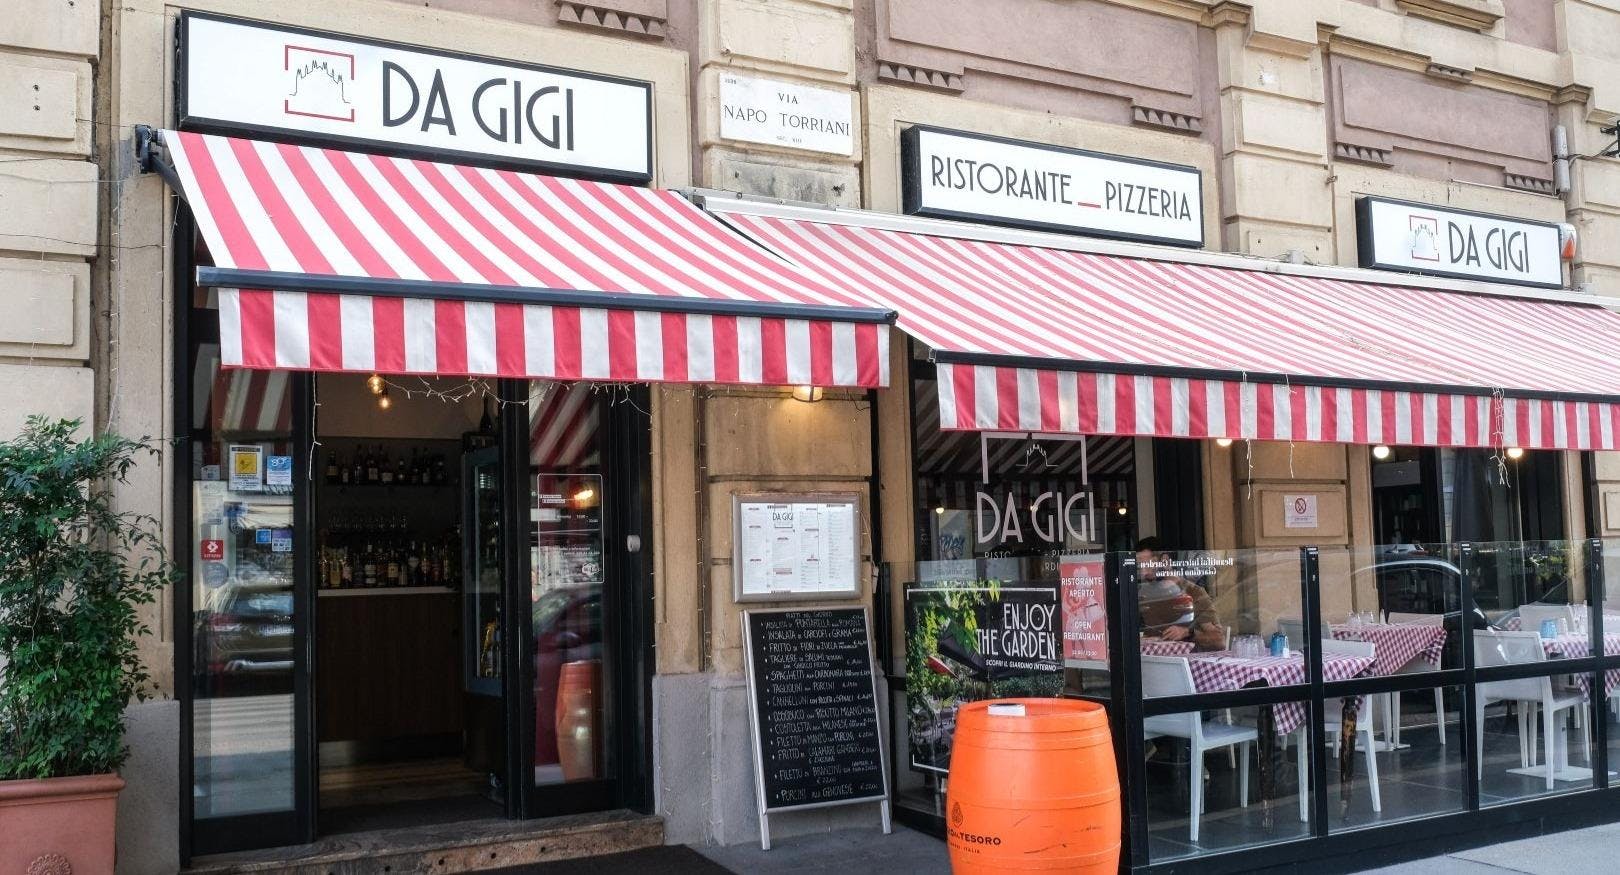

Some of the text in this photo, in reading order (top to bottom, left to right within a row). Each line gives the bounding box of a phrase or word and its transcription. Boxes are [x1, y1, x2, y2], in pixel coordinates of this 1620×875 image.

[383, 61, 574, 151] DA GIGI
[778, 92, 798, 105] VIA
[724, 105, 850, 136] NAPO TORRIANI
[932, 155, 1192, 221] RISTORANTE PIZZERIA
[1448, 222, 1530, 273] DA GIGI
[977, 491, 1096, 544] DA GIGI
[1061, 576, 1103, 587] RISTORANTE
[1069, 589, 1095, 598] APERTO
[1003, 603, 1056, 632] ENJOY
[1074, 621, 1092, 630] OPEN
[769, 641, 792, 653] FRITTO
[975, 628, 1056, 660] THE GARDEN
[1063, 632, 1105, 642] RESTAURANT
[985, 659, 1057, 672] SCOPRI IL GIARDINO INTERNO
